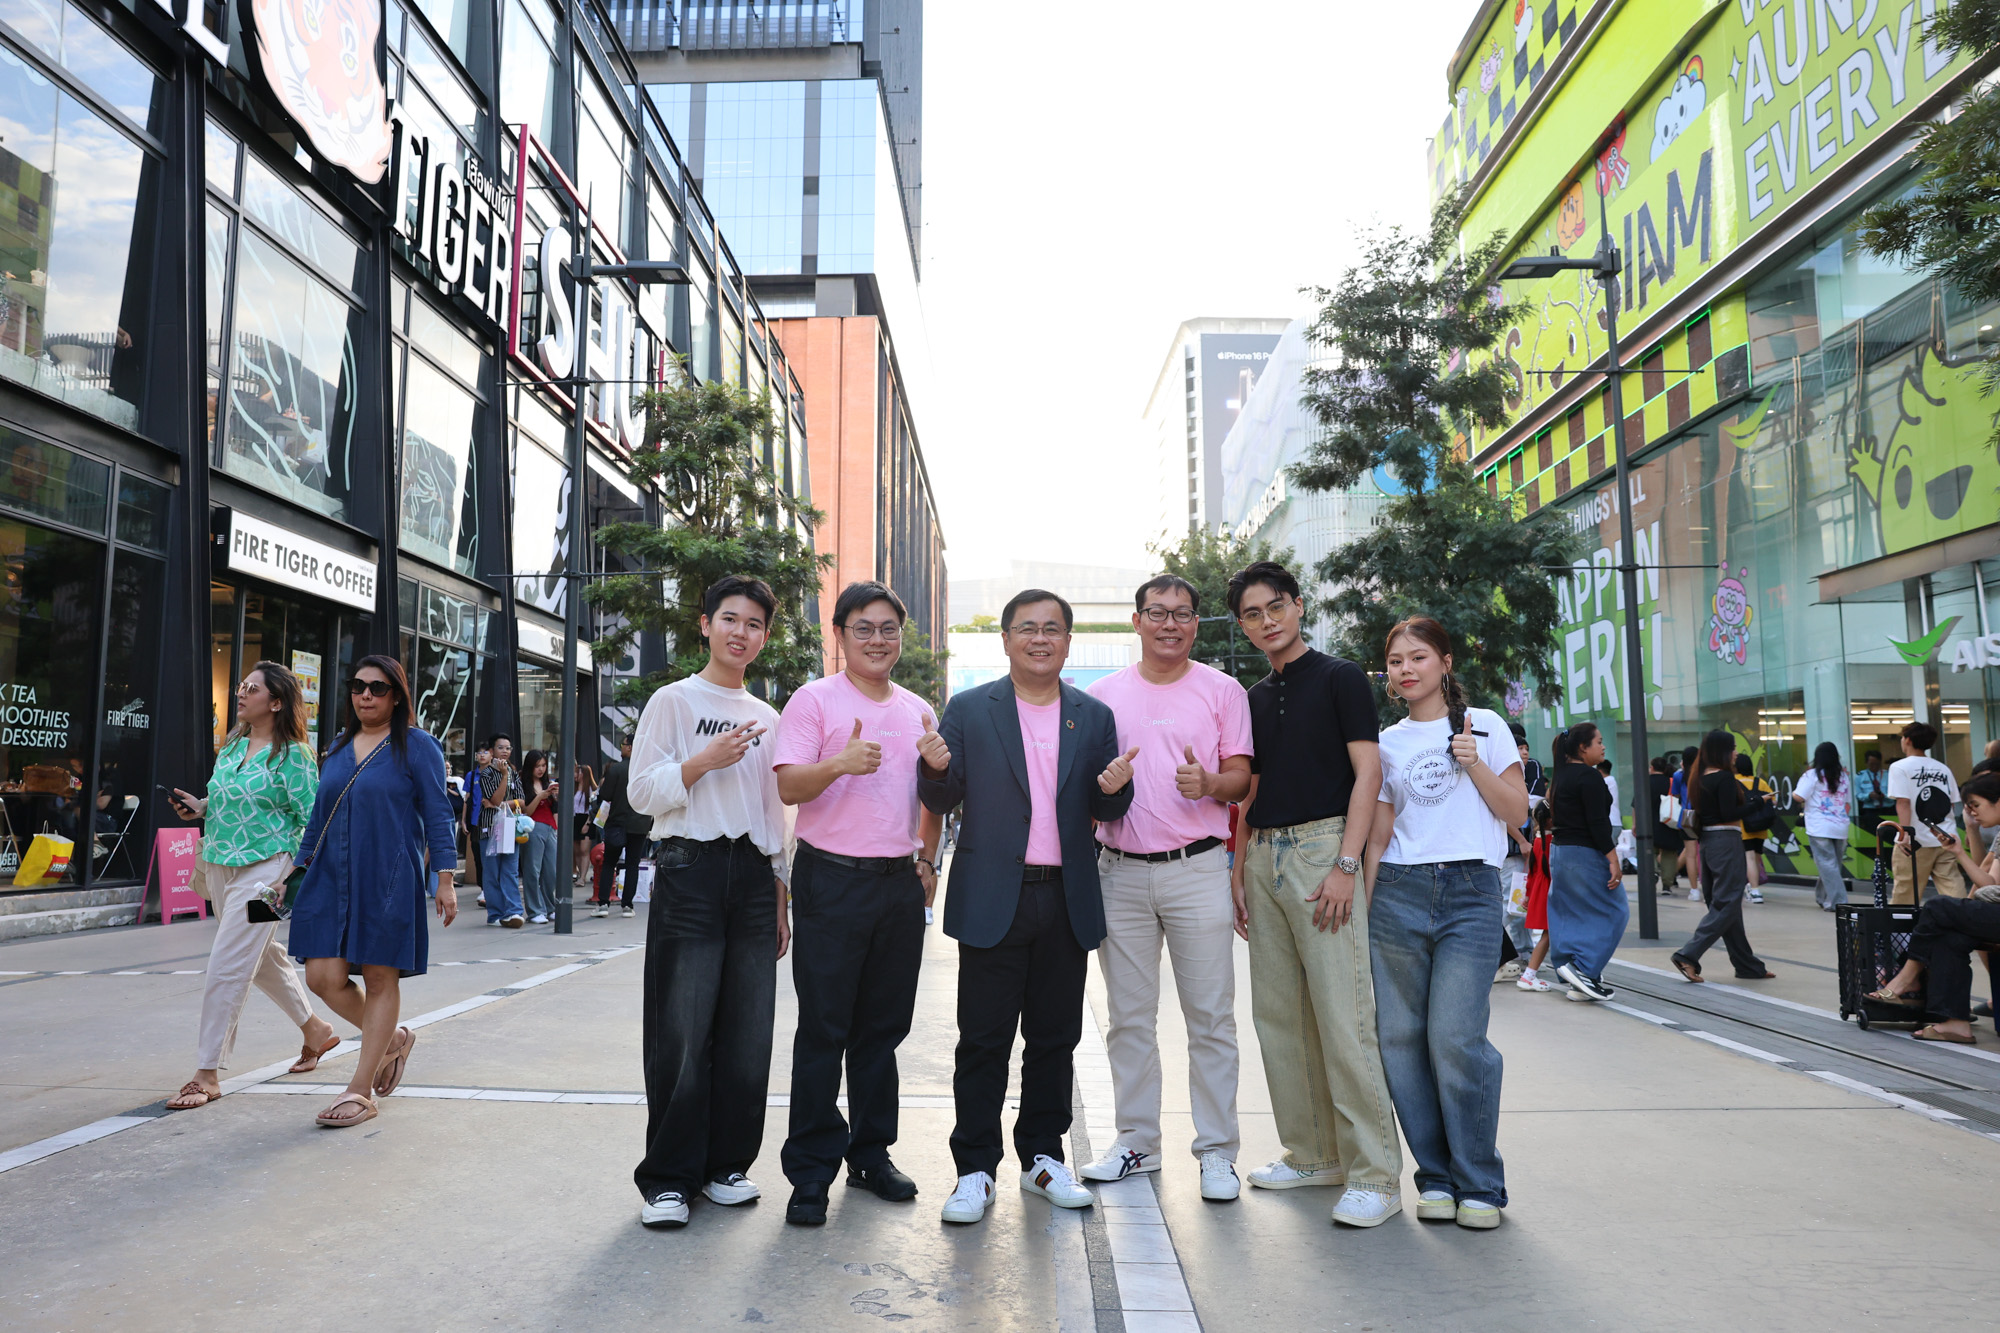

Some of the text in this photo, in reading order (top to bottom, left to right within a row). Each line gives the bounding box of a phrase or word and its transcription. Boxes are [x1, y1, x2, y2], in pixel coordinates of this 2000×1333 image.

[391, 100, 513, 334] TIGER
[1224, 351, 1252, 361] iPhone
[1253, 352, 1262, 361] 16
[234, 528, 373, 598] FIRE TIGER COFFEE
[1951, 632, 2000, 674] AIS
[11, 683, 37, 705] TEA
[106, 709, 150, 730] FIRE TIGER
[1152, 718, 1175, 727] PMCU
[1, 727, 68, 749] DESSERTS
[168, 840, 186, 853] Juicy
